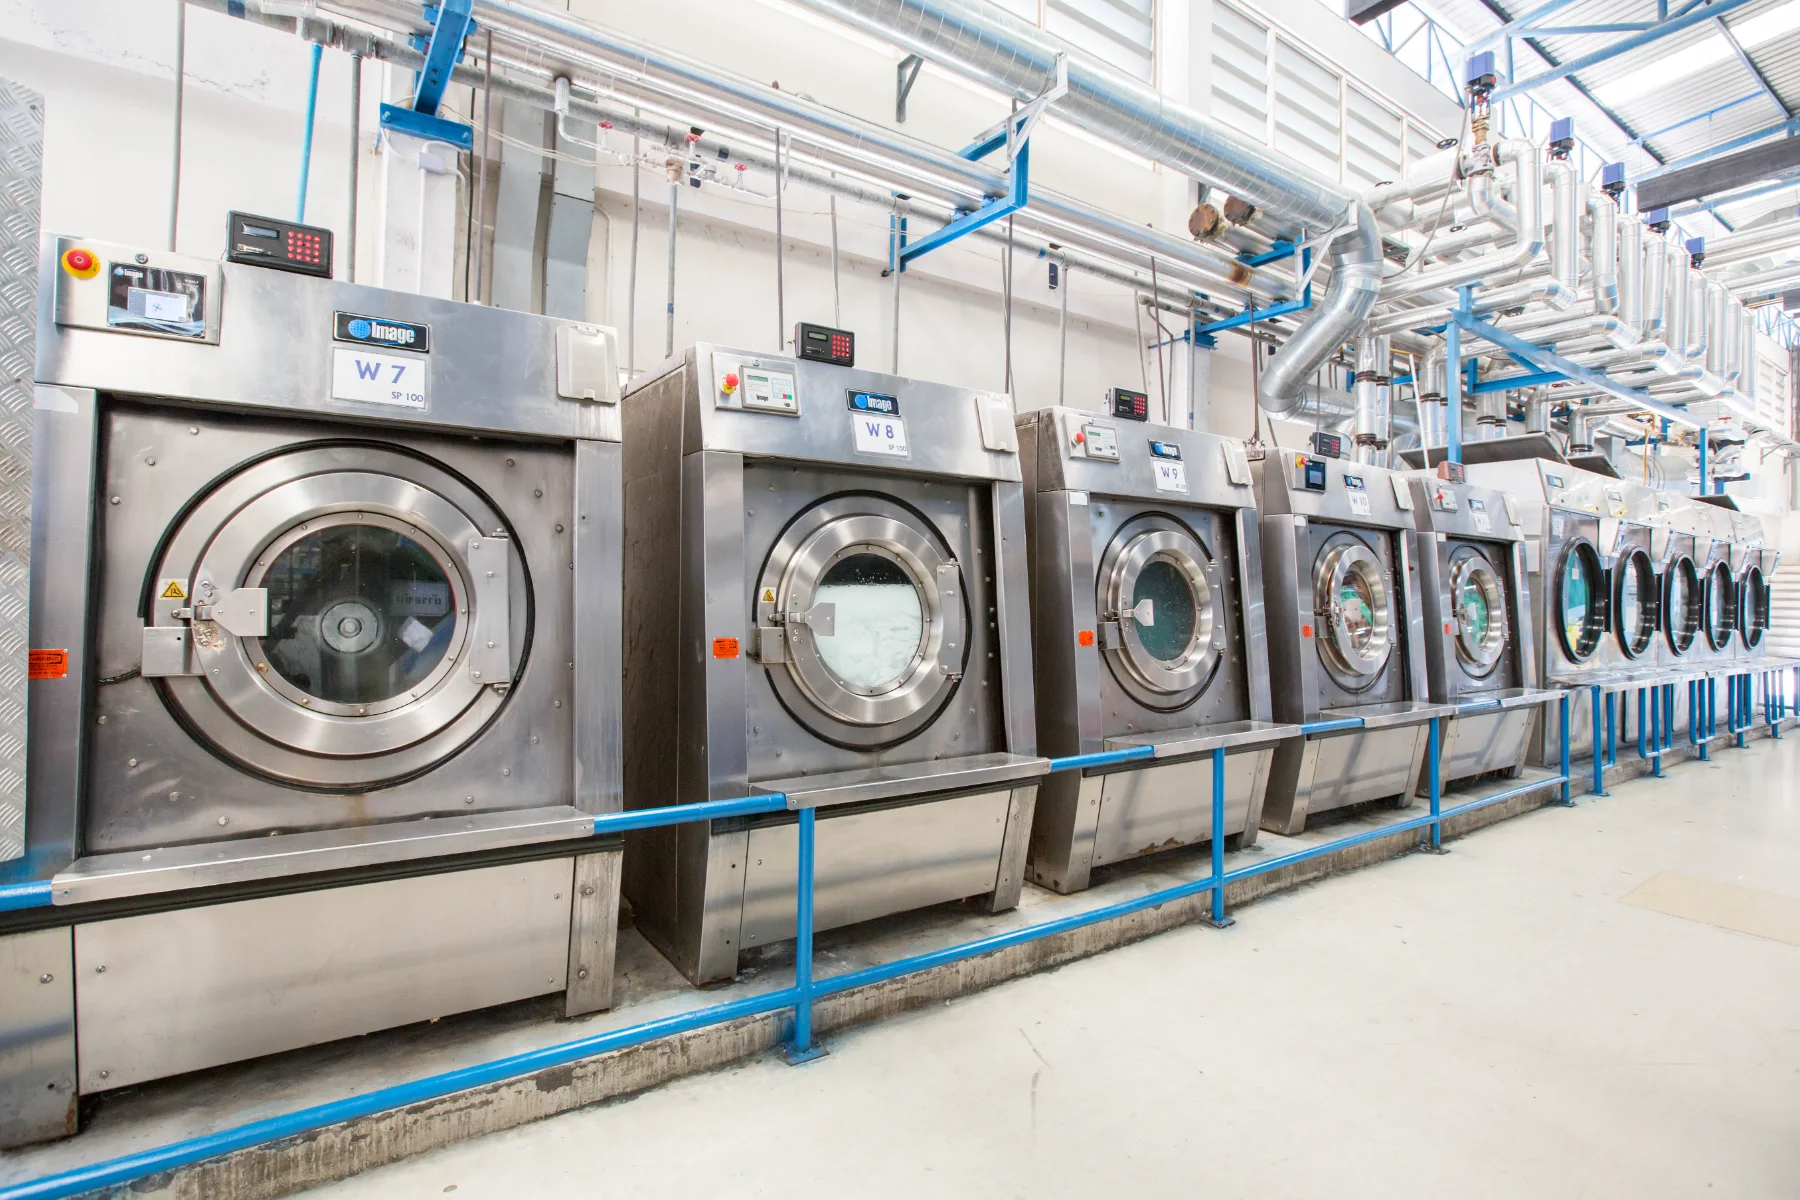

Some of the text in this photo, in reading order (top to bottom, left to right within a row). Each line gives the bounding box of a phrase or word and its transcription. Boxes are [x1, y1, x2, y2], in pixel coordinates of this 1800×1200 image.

[371, 321, 415, 344] Image
[355, 359, 406, 384] W 7
[391, 391, 424, 402] SP 100
[866, 395, 892, 412] Image
[865, 421, 894, 439] W 8
[1160, 466, 1178, 479] W 9
